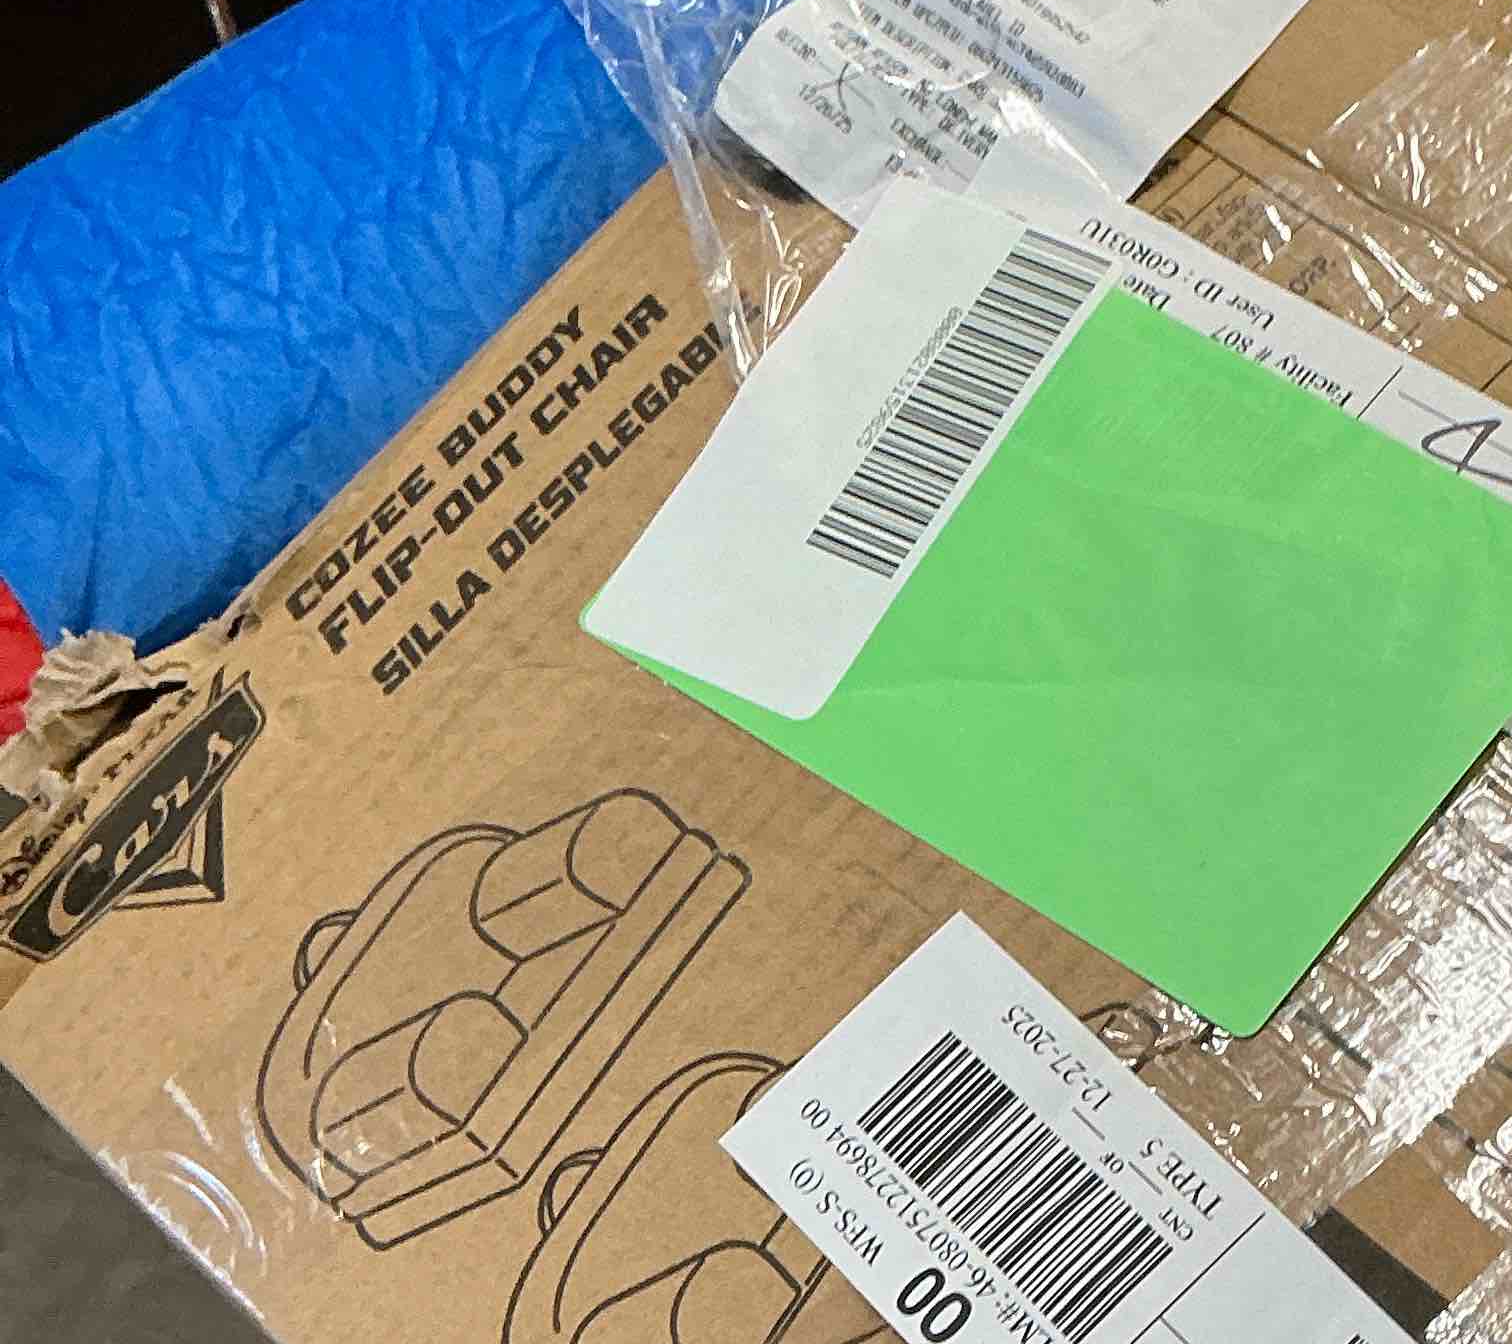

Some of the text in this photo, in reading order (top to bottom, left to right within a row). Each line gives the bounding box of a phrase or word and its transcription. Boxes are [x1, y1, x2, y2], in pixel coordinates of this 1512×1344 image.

[1193, 280, 1224, 303] ID
[1226, 295, 1275, 332] User
[1123, 276, 1353, 408] Facility # 807 Date
[284, 303, 585, 622] COZEE BUDDY
[317, 293, 669, 655] FLIP-OUT CHAIR
[371, 569, 493, 696] SILLA
[800, 1099, 831, 1130] 00
[1001, 1005, 1222, 1217] TYPE 5 12-27-2025
[789, 1159, 825, 1194] (0)
[816, 1191, 884, 1267] WFS-S
[1158, 1207, 1194, 1241] CNT
[896, 1267, 973, 1344] 00
